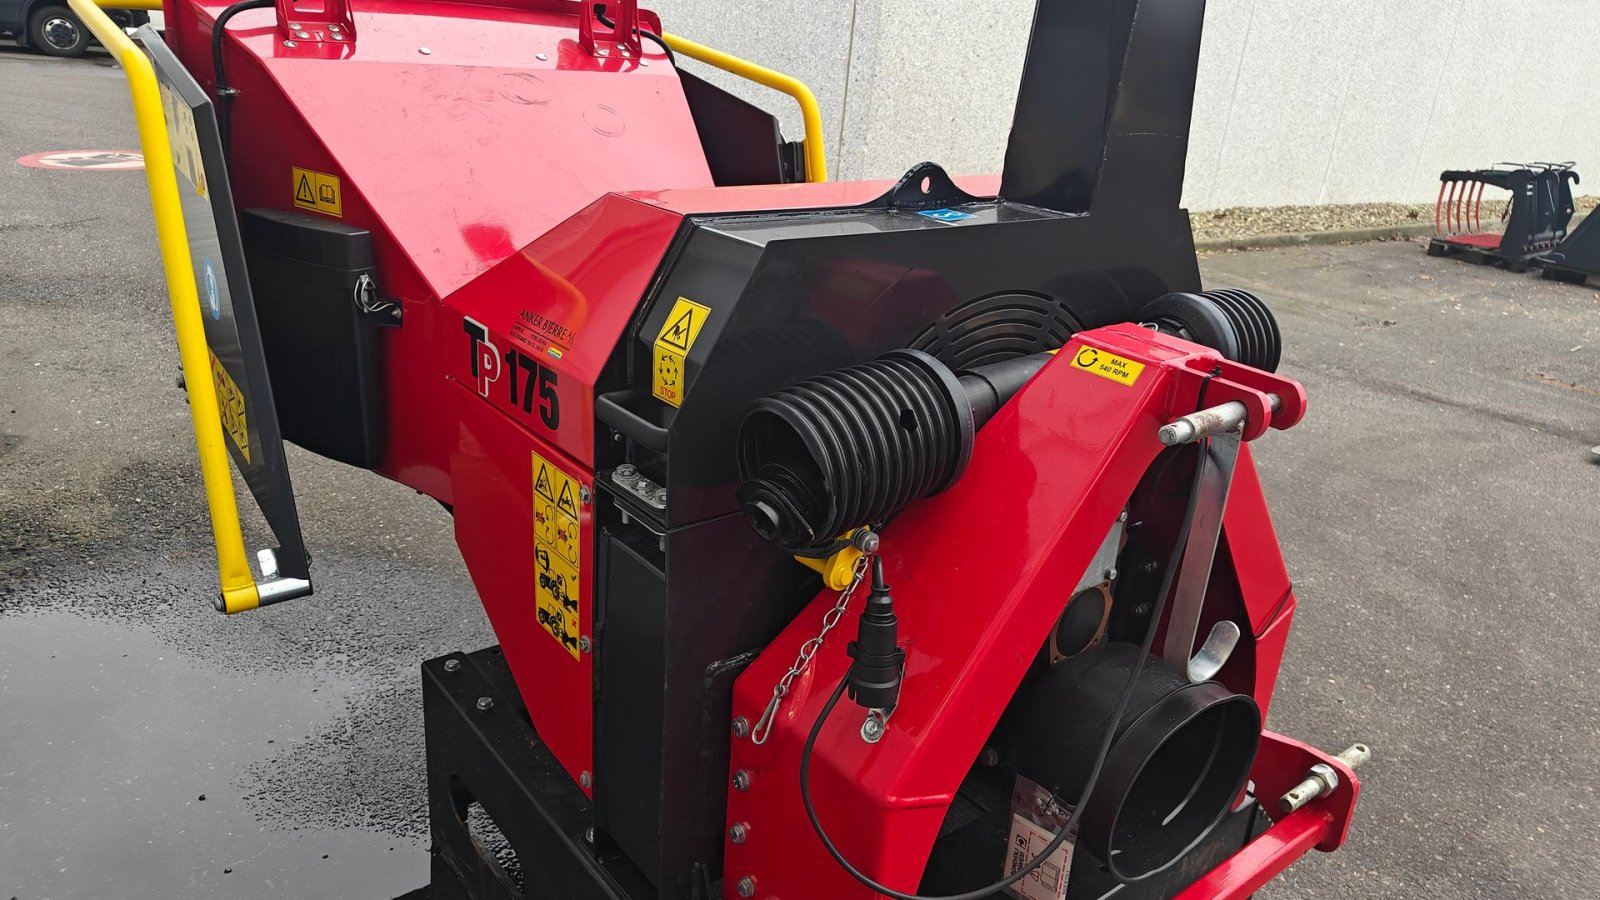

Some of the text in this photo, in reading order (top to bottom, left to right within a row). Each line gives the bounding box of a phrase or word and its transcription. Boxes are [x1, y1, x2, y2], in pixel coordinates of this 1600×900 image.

[520, 309, 543, 327] ANKER
[541, 319, 568, 341] BJERRE
[1100, 364, 1129, 378] 540 RPM
[1111, 359, 1128, 369] MAX
[464, 316, 560, 431] TP 175
[661, 386, 676, 399] STOP
